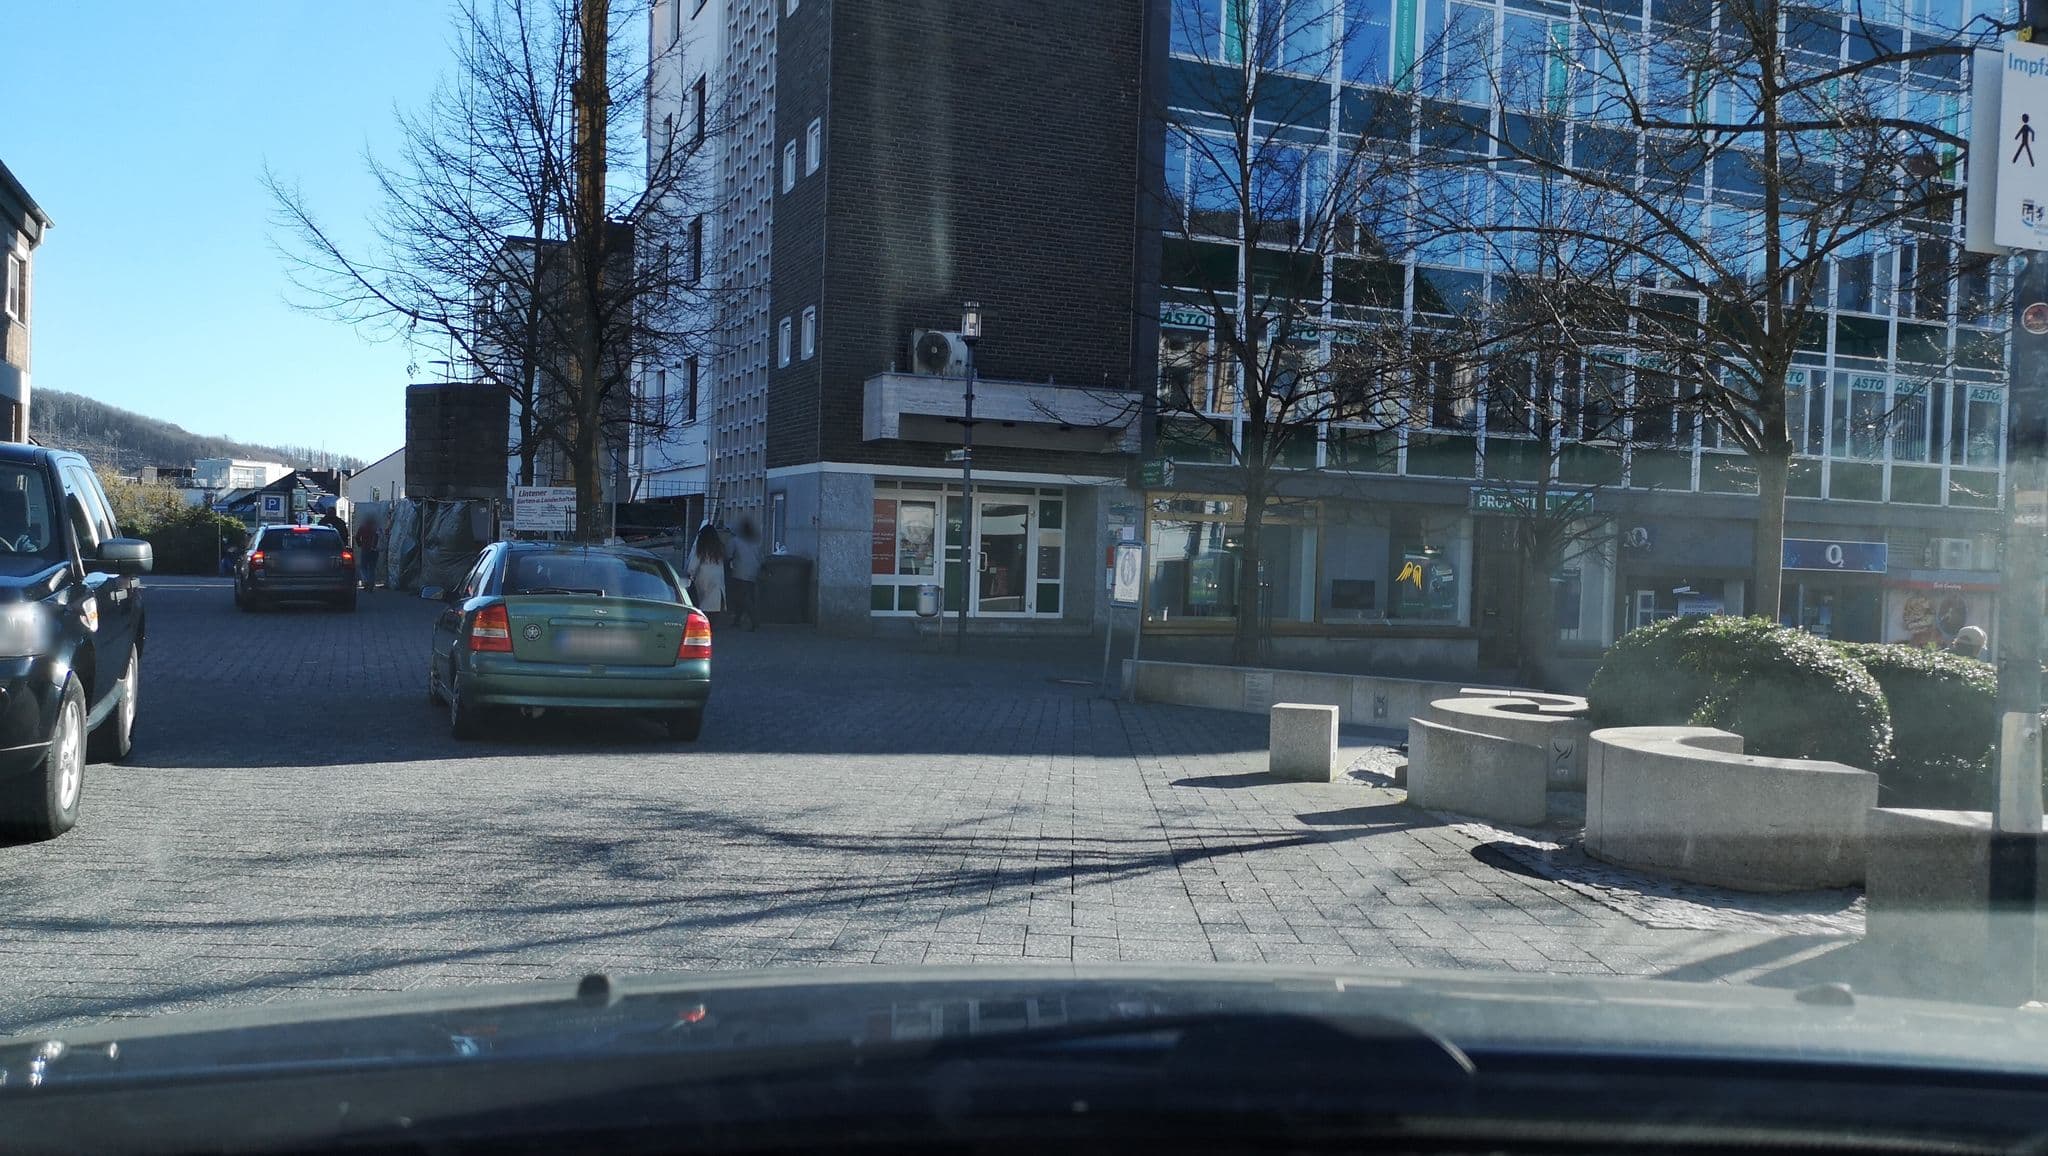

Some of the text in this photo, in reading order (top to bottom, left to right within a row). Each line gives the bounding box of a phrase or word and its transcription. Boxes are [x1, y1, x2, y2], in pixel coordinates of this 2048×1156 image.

[1164, 311, 1207, 326] ASTO
[1852, 378, 1884, 390] ASTO
[1896, 382, 1926, 394] ASTO
[1971, 388, 2000, 400] ASTO
[269, 498, 277, 508] P
